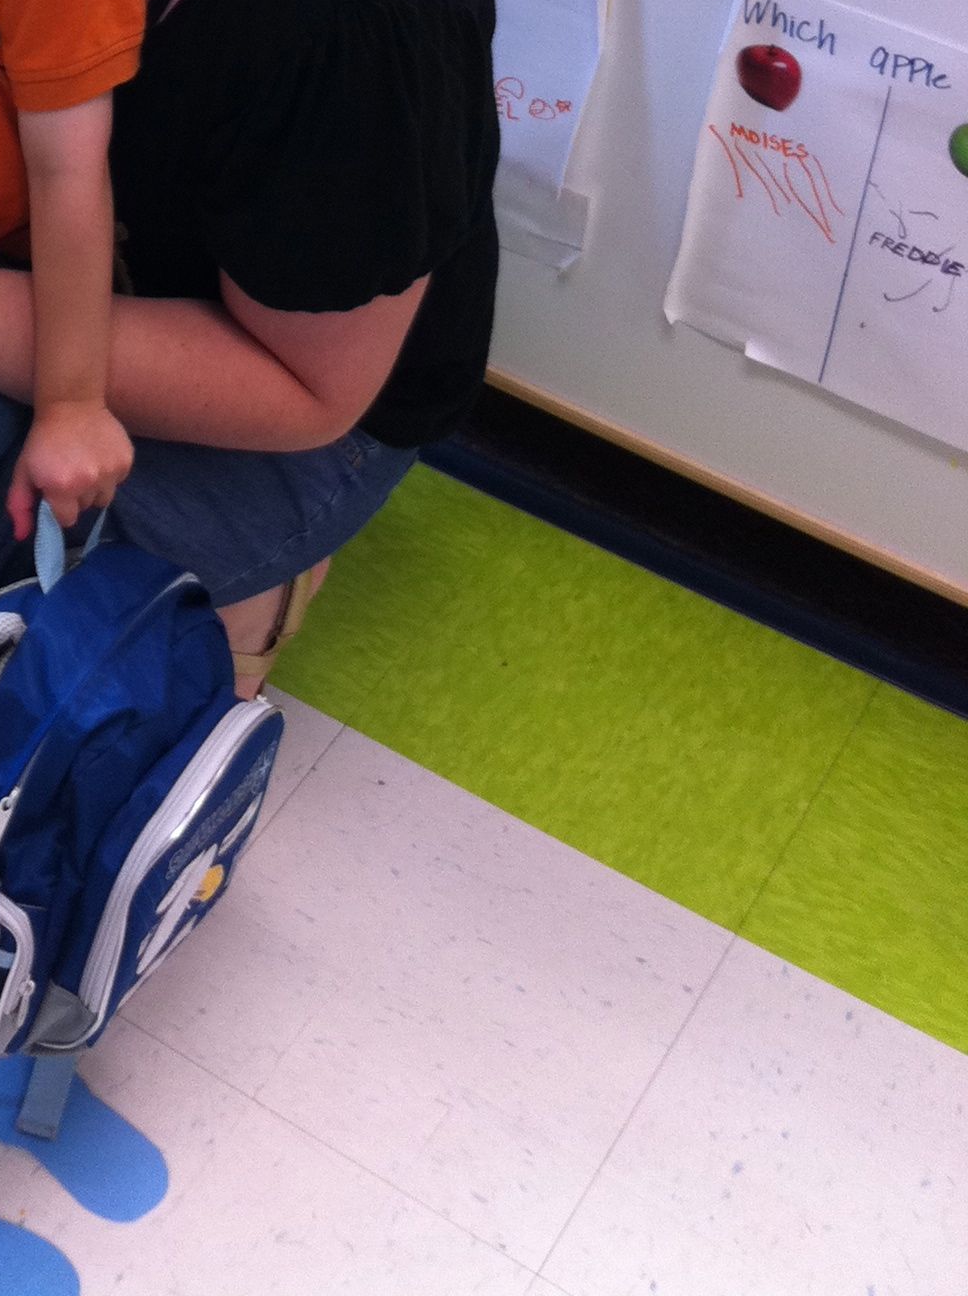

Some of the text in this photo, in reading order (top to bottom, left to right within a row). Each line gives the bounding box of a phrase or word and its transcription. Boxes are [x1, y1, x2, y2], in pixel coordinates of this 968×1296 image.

[869, 46, 952, 90] apple
[729, 121, 809, 160] MOISES
[868, 231, 966, 278] FREDDIE
